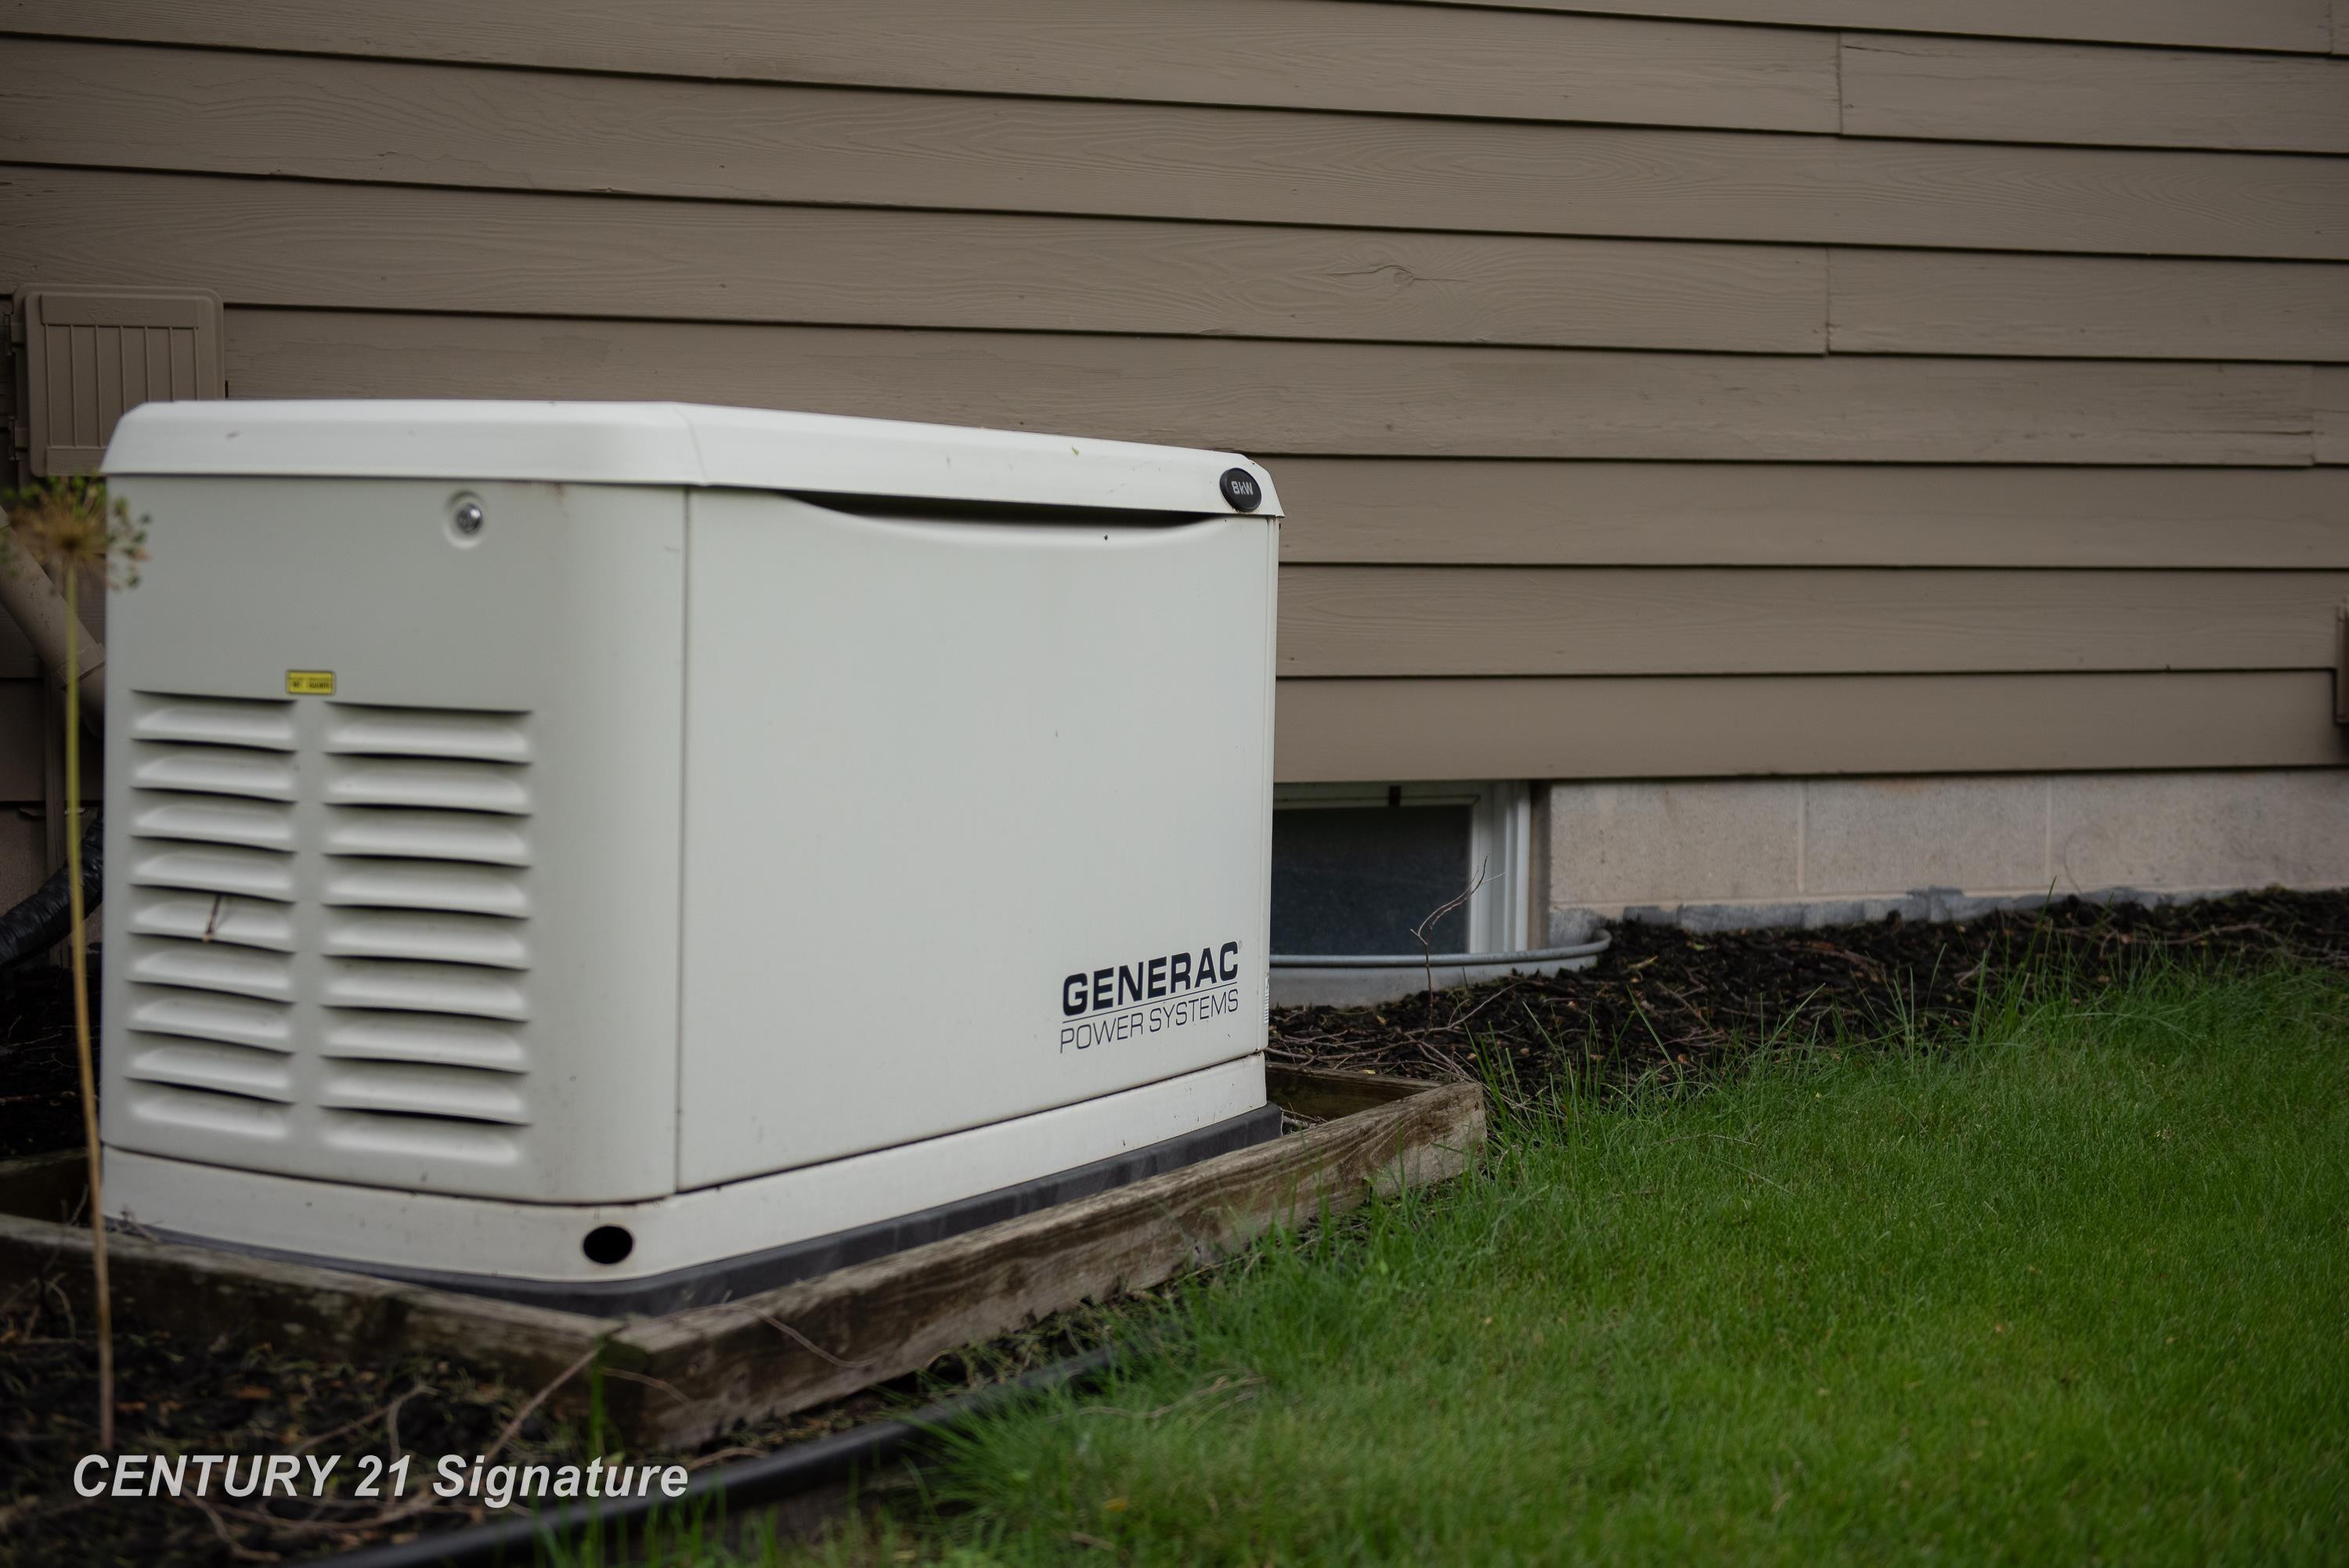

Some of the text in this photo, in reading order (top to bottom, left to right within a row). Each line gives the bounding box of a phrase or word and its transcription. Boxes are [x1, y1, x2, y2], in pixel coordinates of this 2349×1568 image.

[1063, 940, 1239, 1016] GENERAC
[1060, 988, 1239, 1054] POWER SYSTEMS
